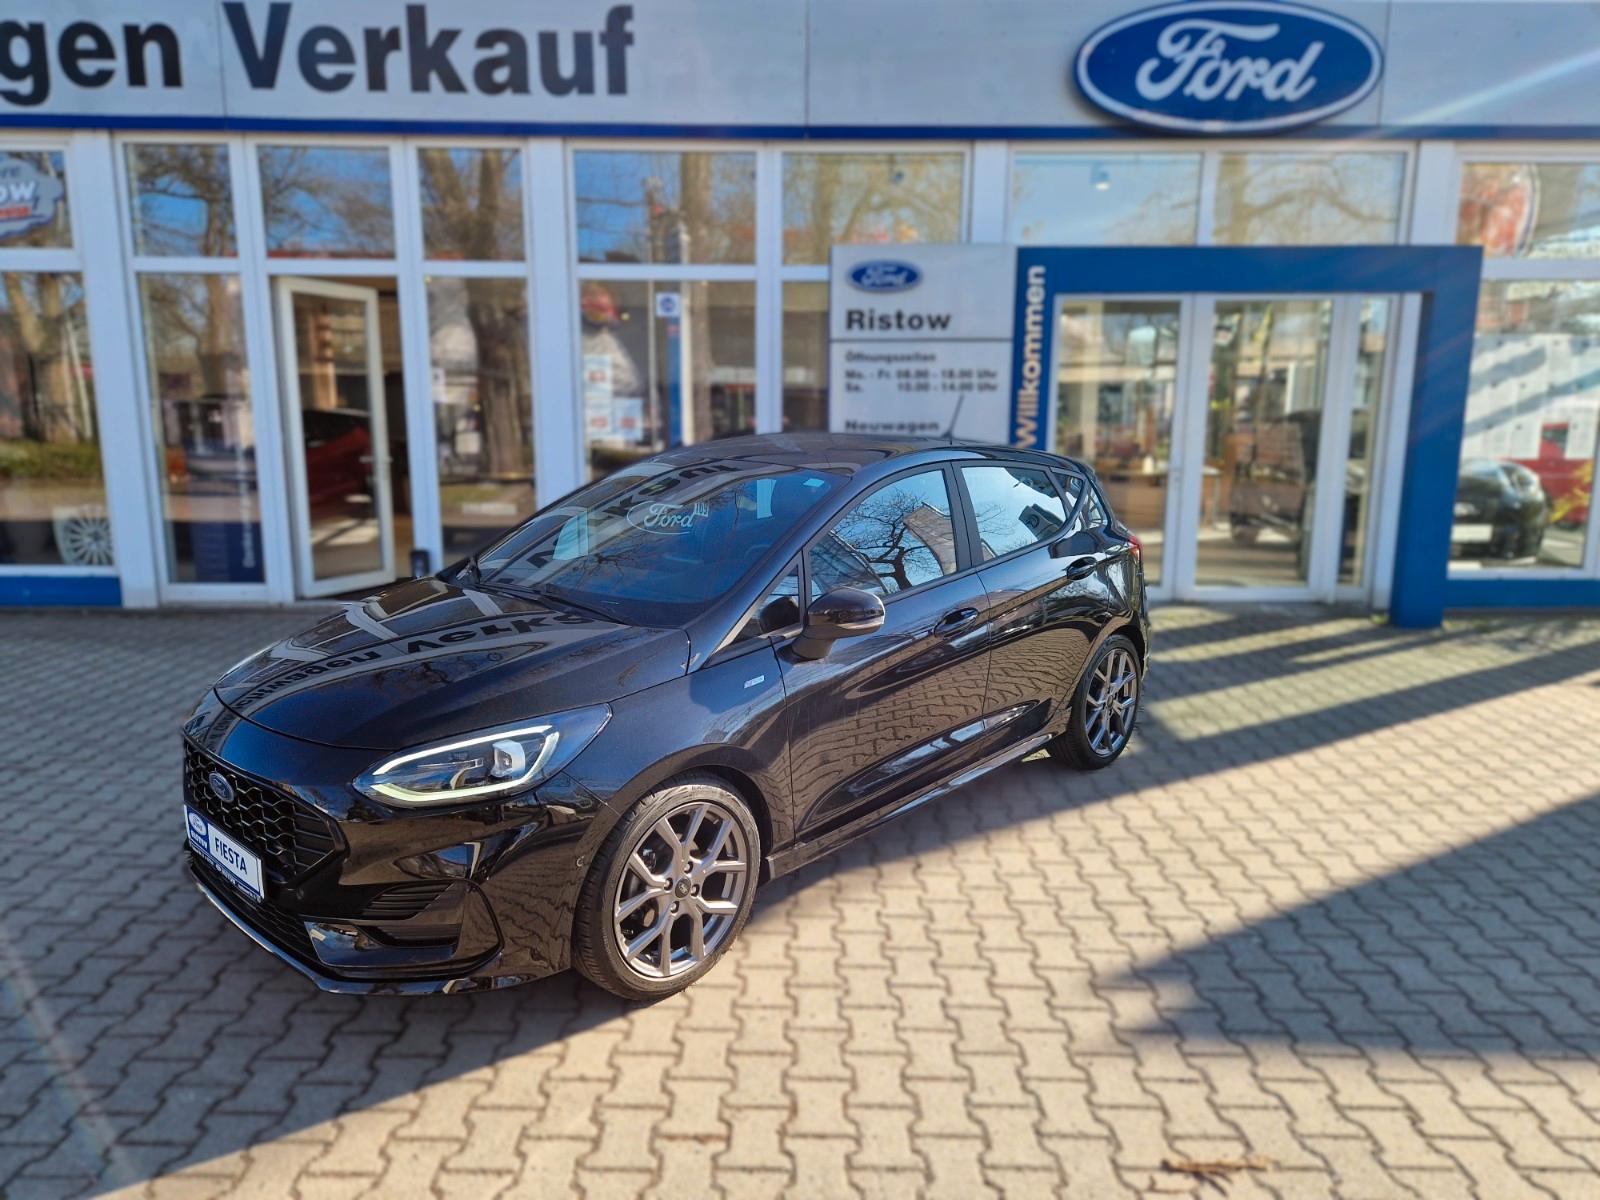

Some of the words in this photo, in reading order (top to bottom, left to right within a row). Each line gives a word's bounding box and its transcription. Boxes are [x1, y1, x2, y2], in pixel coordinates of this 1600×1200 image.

[221, 2, 634, 97] Verkauf
[1135, 18, 1325, 101] Ford
[860, 264, 909, 288] Ford
[845, 309, 952, 331] Ristow
[1014, 265, 1047, 449] Willkommen
[976, 368, 998, 380] Uhr
[976, 382, 998, 393] Uhr
[844, 420, 940, 433] Neuwagen
[643, 503, 695, 529] Ford
[215, 837, 248, 875] FIESTA
